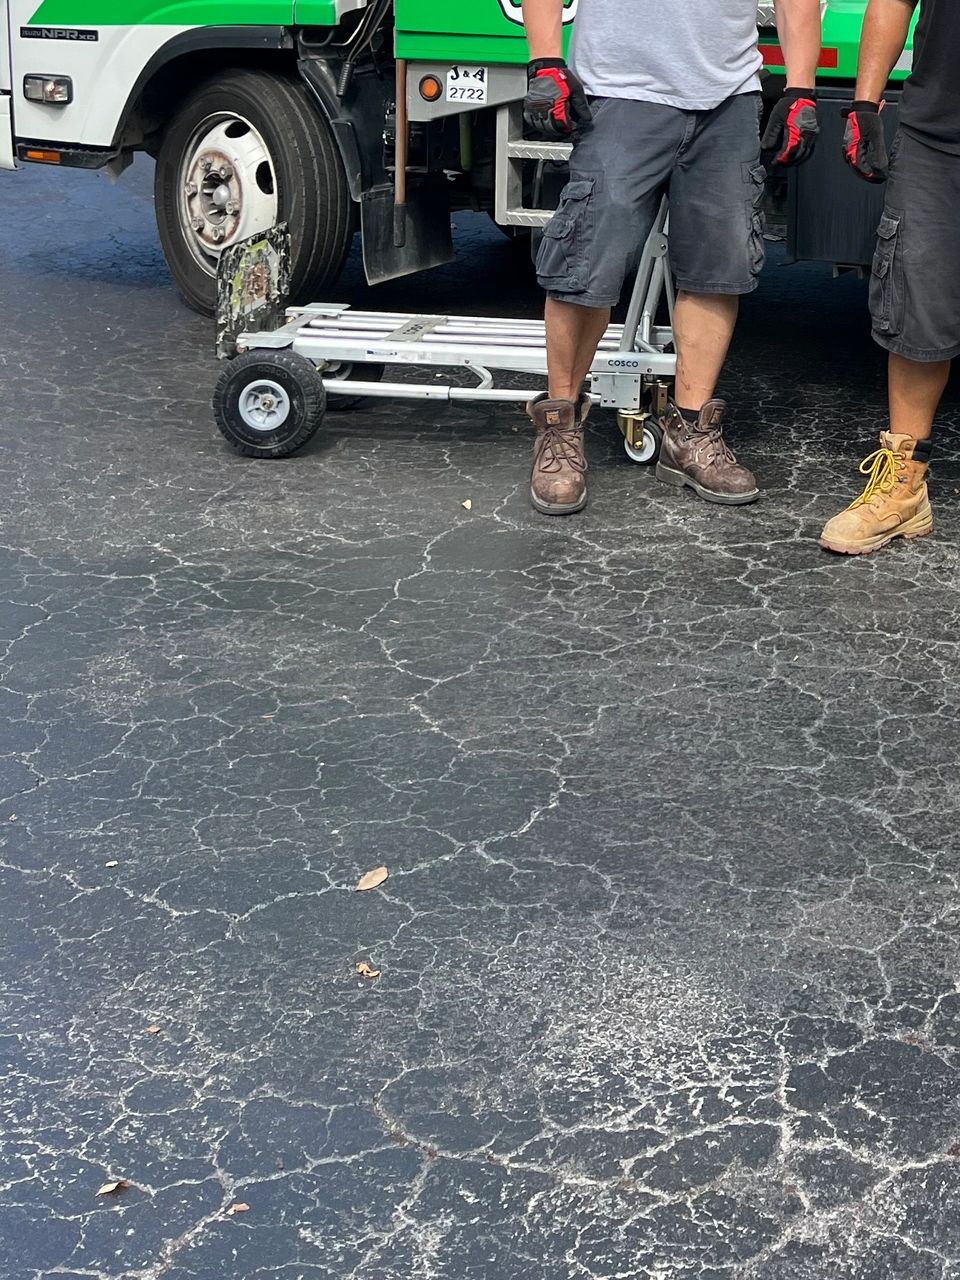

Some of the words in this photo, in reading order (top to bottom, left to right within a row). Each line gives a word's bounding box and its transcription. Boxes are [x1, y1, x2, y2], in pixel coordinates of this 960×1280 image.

[42, 29, 78, 39] NPR
[450, 66, 460, 80] J
[463, 70, 470, 78] &
[472, 67, 485, 82] A
[450, 87, 485, 100] 2722
[608, 359, 639, 368] COSCO
